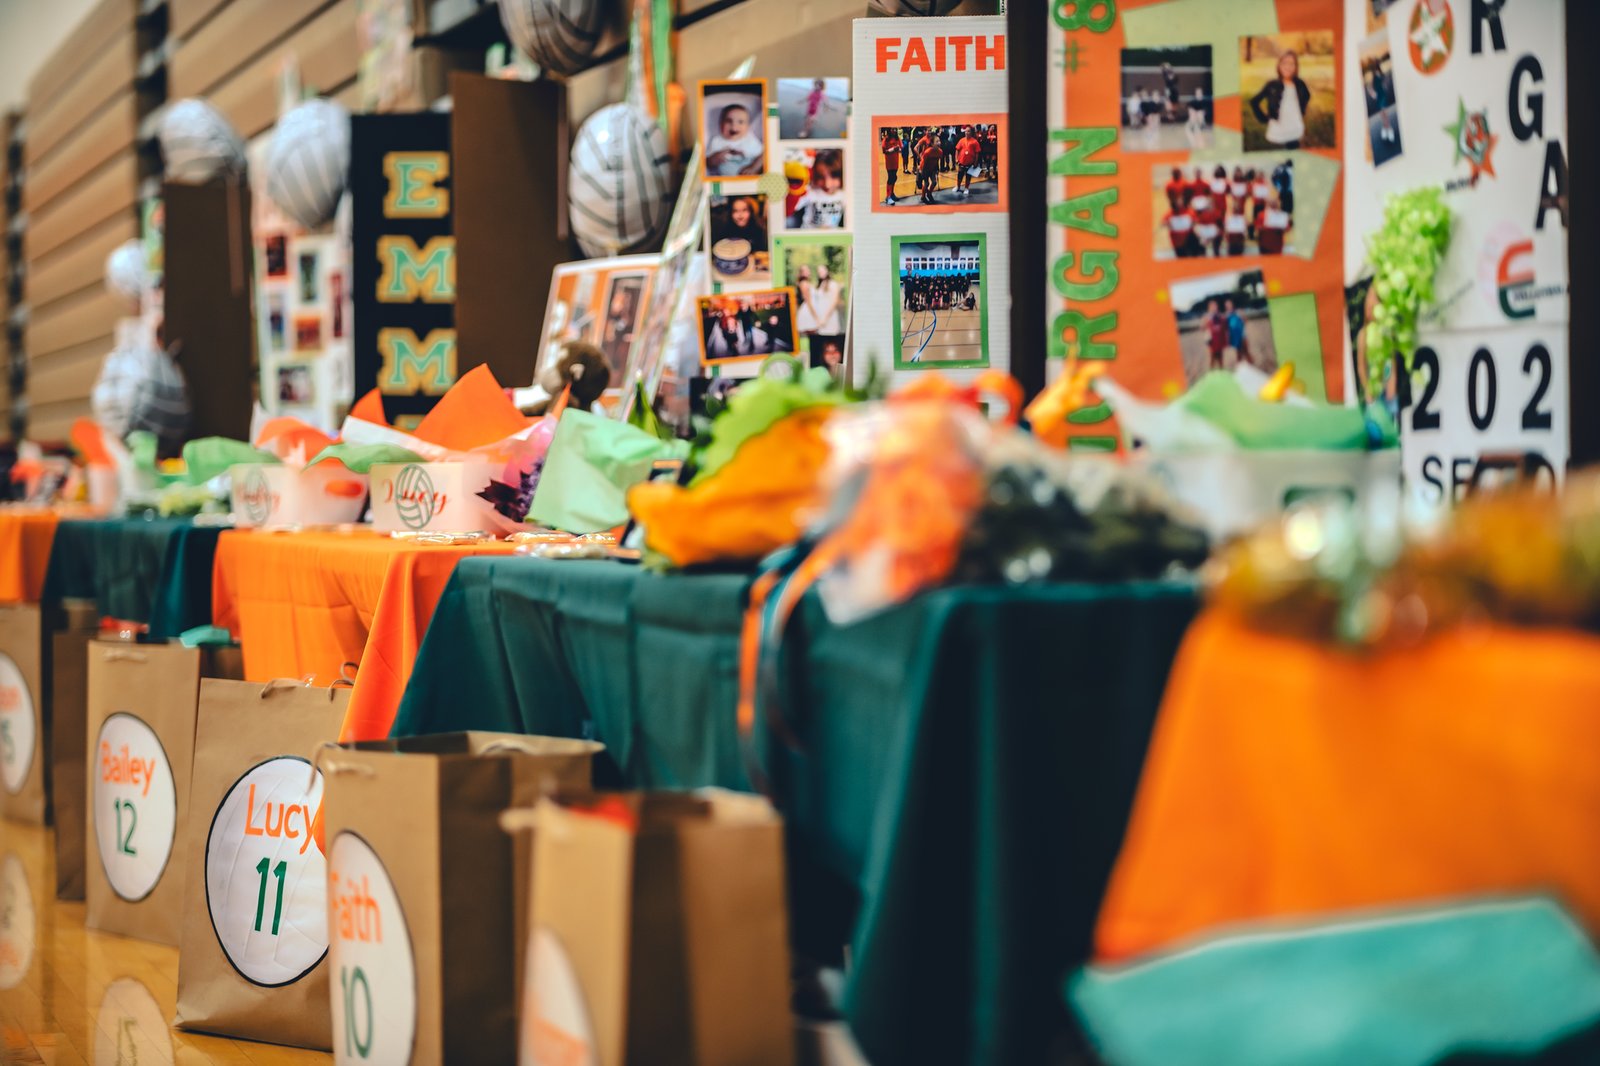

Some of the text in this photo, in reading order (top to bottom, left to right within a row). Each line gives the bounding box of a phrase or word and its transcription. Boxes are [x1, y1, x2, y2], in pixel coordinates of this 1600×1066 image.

[875, 35, 1005, 73] FAITH
[100, 739, 155, 798] Bailey
[115, 797, 138, 857] 12
[245, 783, 317, 855] Lucy
[256, 857, 287, 936] 11
[342, 965, 373, 1059] 10
